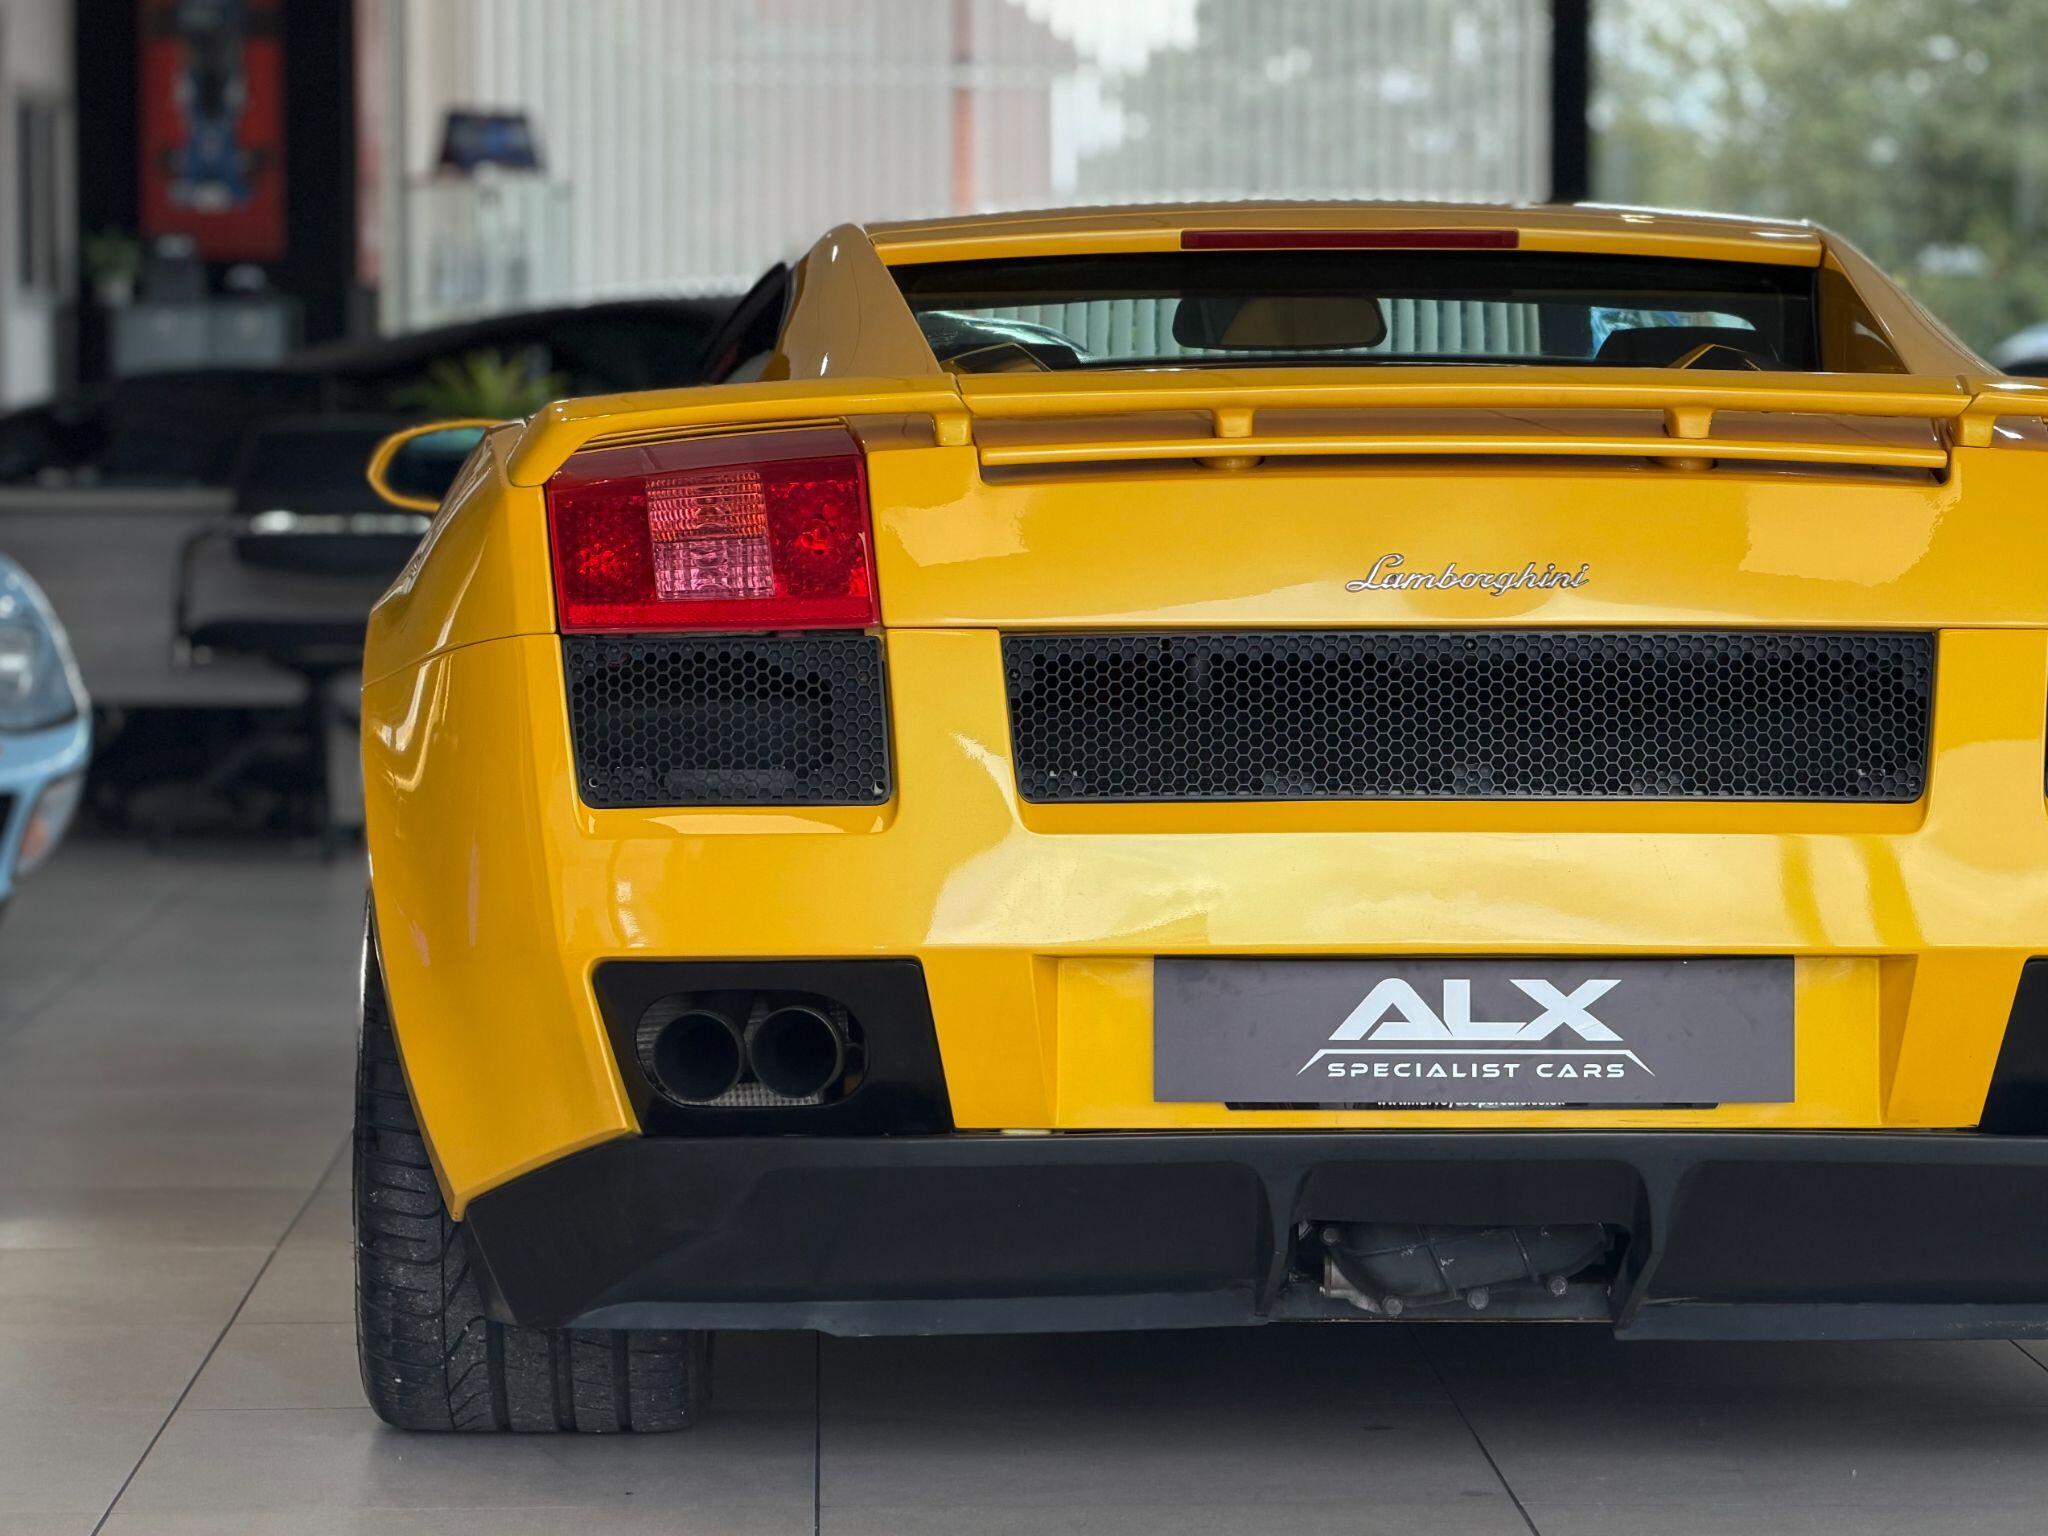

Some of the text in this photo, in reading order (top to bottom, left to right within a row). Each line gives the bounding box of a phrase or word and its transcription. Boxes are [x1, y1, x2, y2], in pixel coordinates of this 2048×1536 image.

[1345, 553, 1590, 596] Lamborghini
[1328, 977, 1624, 1041] ALX
[1327, 1062, 1625, 1078] SPECIALIST CARS
